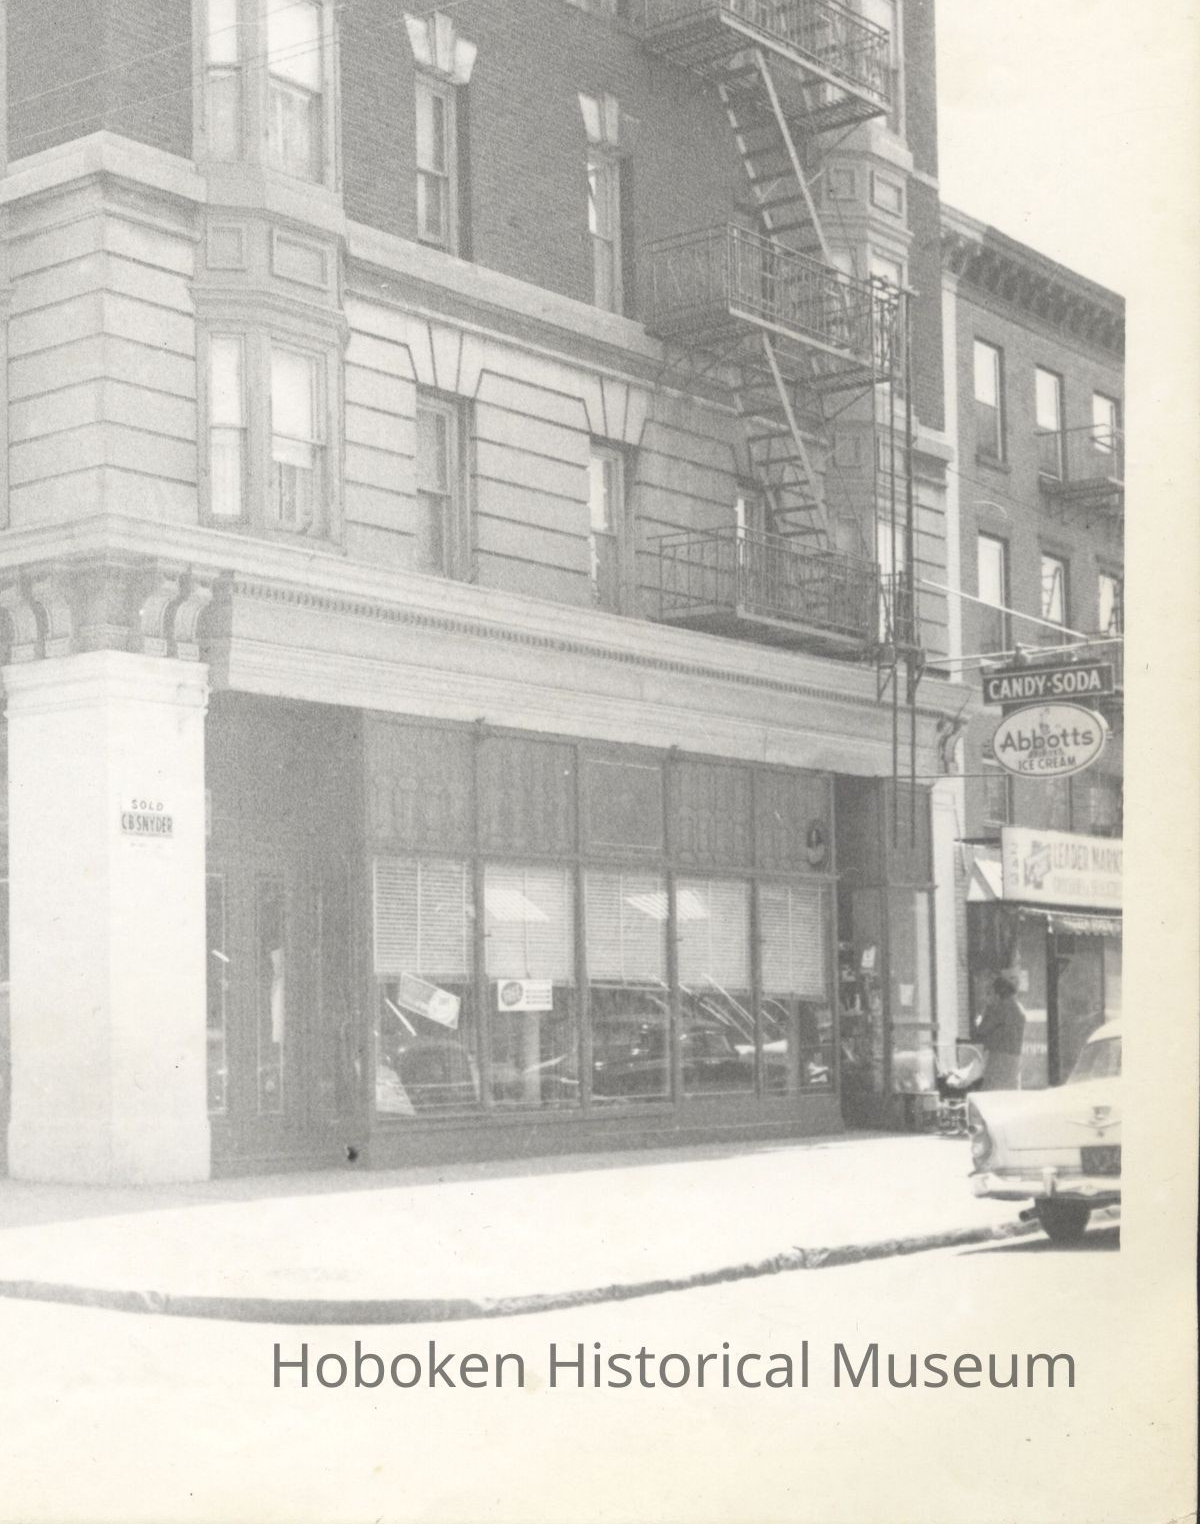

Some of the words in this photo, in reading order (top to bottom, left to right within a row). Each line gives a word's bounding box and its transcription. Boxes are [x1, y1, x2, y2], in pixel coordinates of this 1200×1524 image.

[999, 726, 1095, 753] Abbotts
[1018, 758, 1035, 771] ICE
[1038, 755, 1078, 770] CREAM
[131, 798, 164, 812] SOLD
